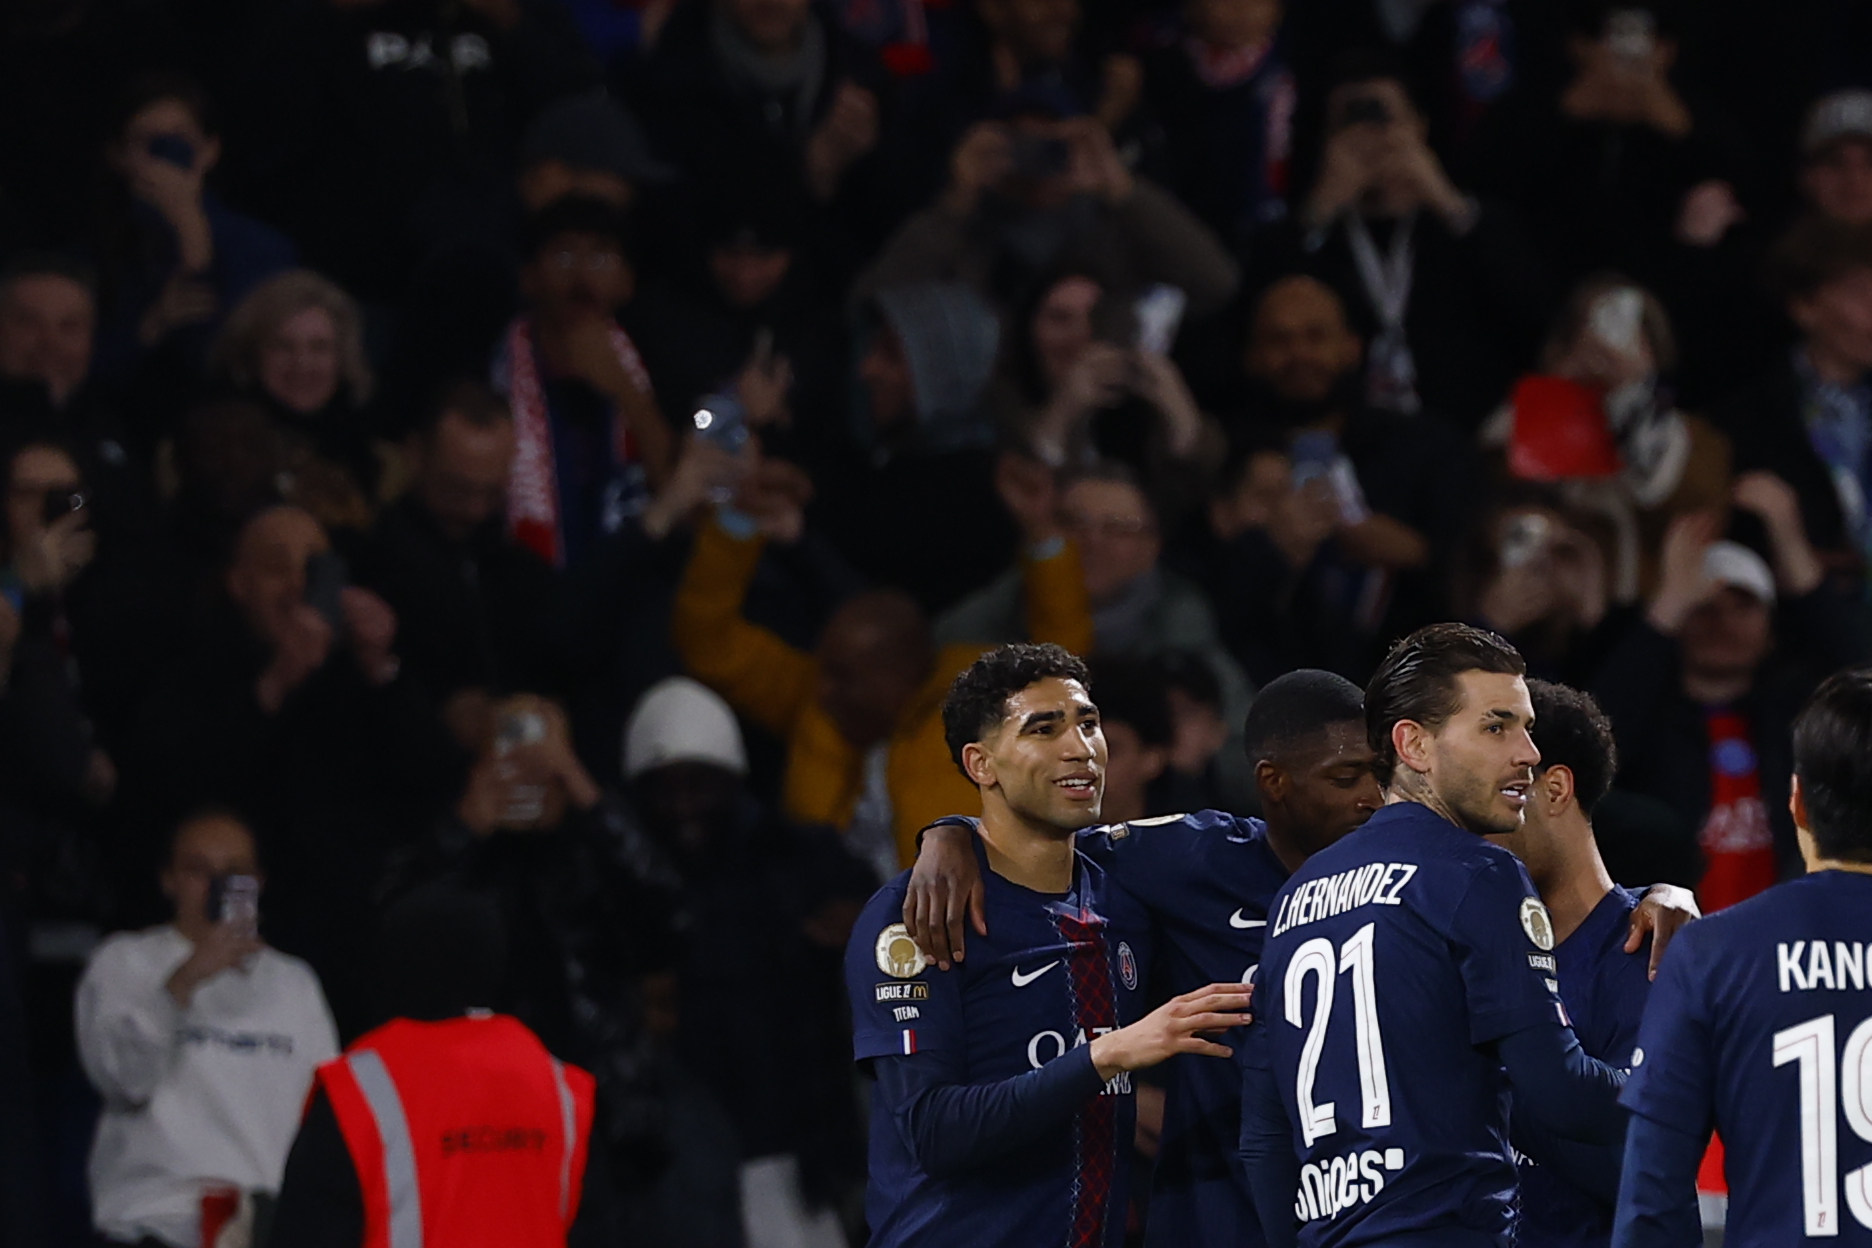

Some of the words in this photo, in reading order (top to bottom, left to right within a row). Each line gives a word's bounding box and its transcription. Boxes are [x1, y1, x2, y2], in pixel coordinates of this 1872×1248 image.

[1272, 862, 1419, 938] L.HERNANDEZ
[876, 985, 902, 1001] LIGUE
[1284, 921, 1392, 1149] 21
